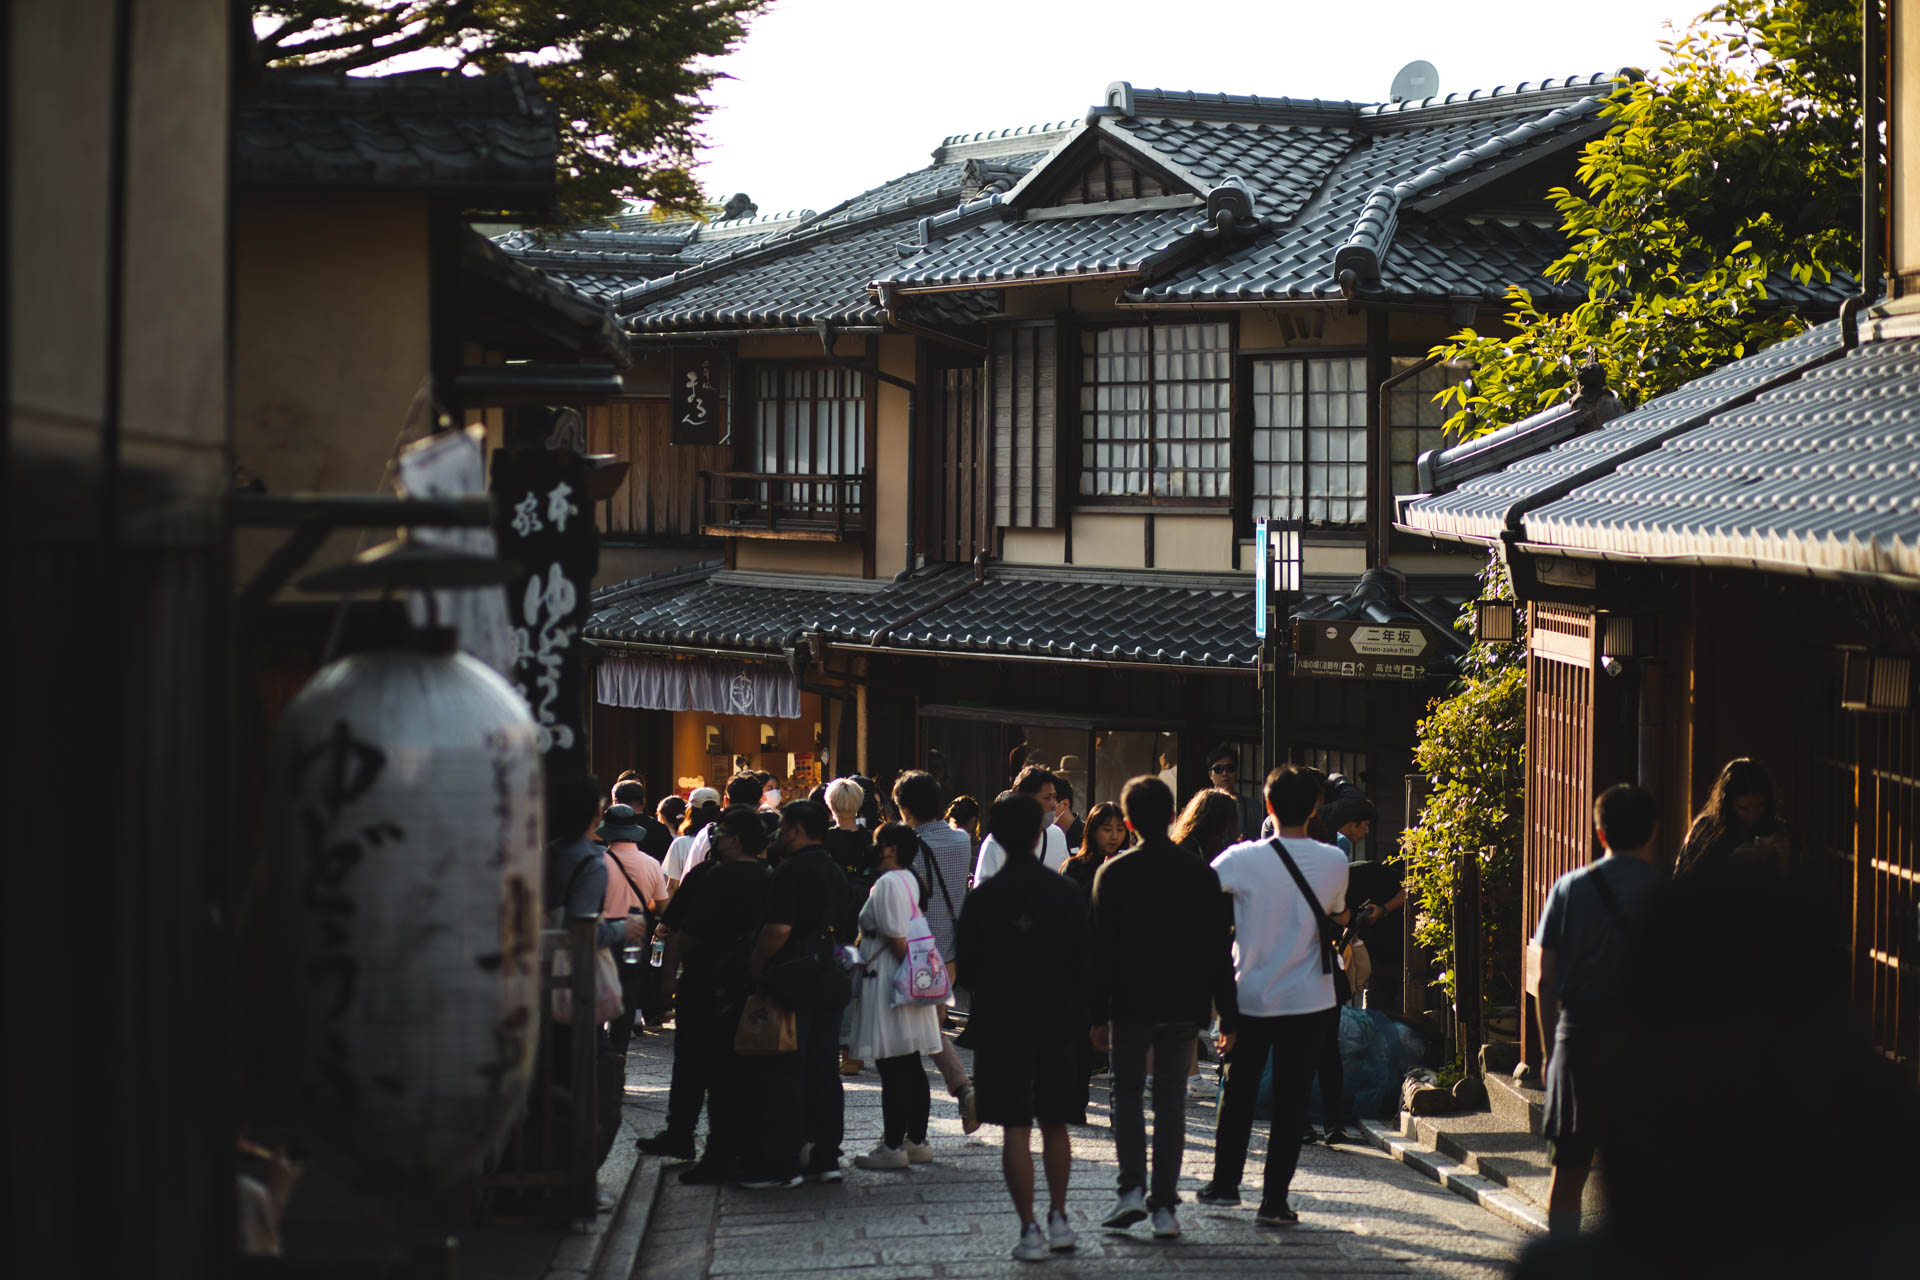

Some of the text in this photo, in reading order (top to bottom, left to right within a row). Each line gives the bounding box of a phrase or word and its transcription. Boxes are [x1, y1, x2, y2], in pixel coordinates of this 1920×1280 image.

[1367, 630, 1411, 644] 二年坂
[1362, 645, 1398, 653] Ninen-zaka
[1375, 664, 1401, 673] 高台寺
